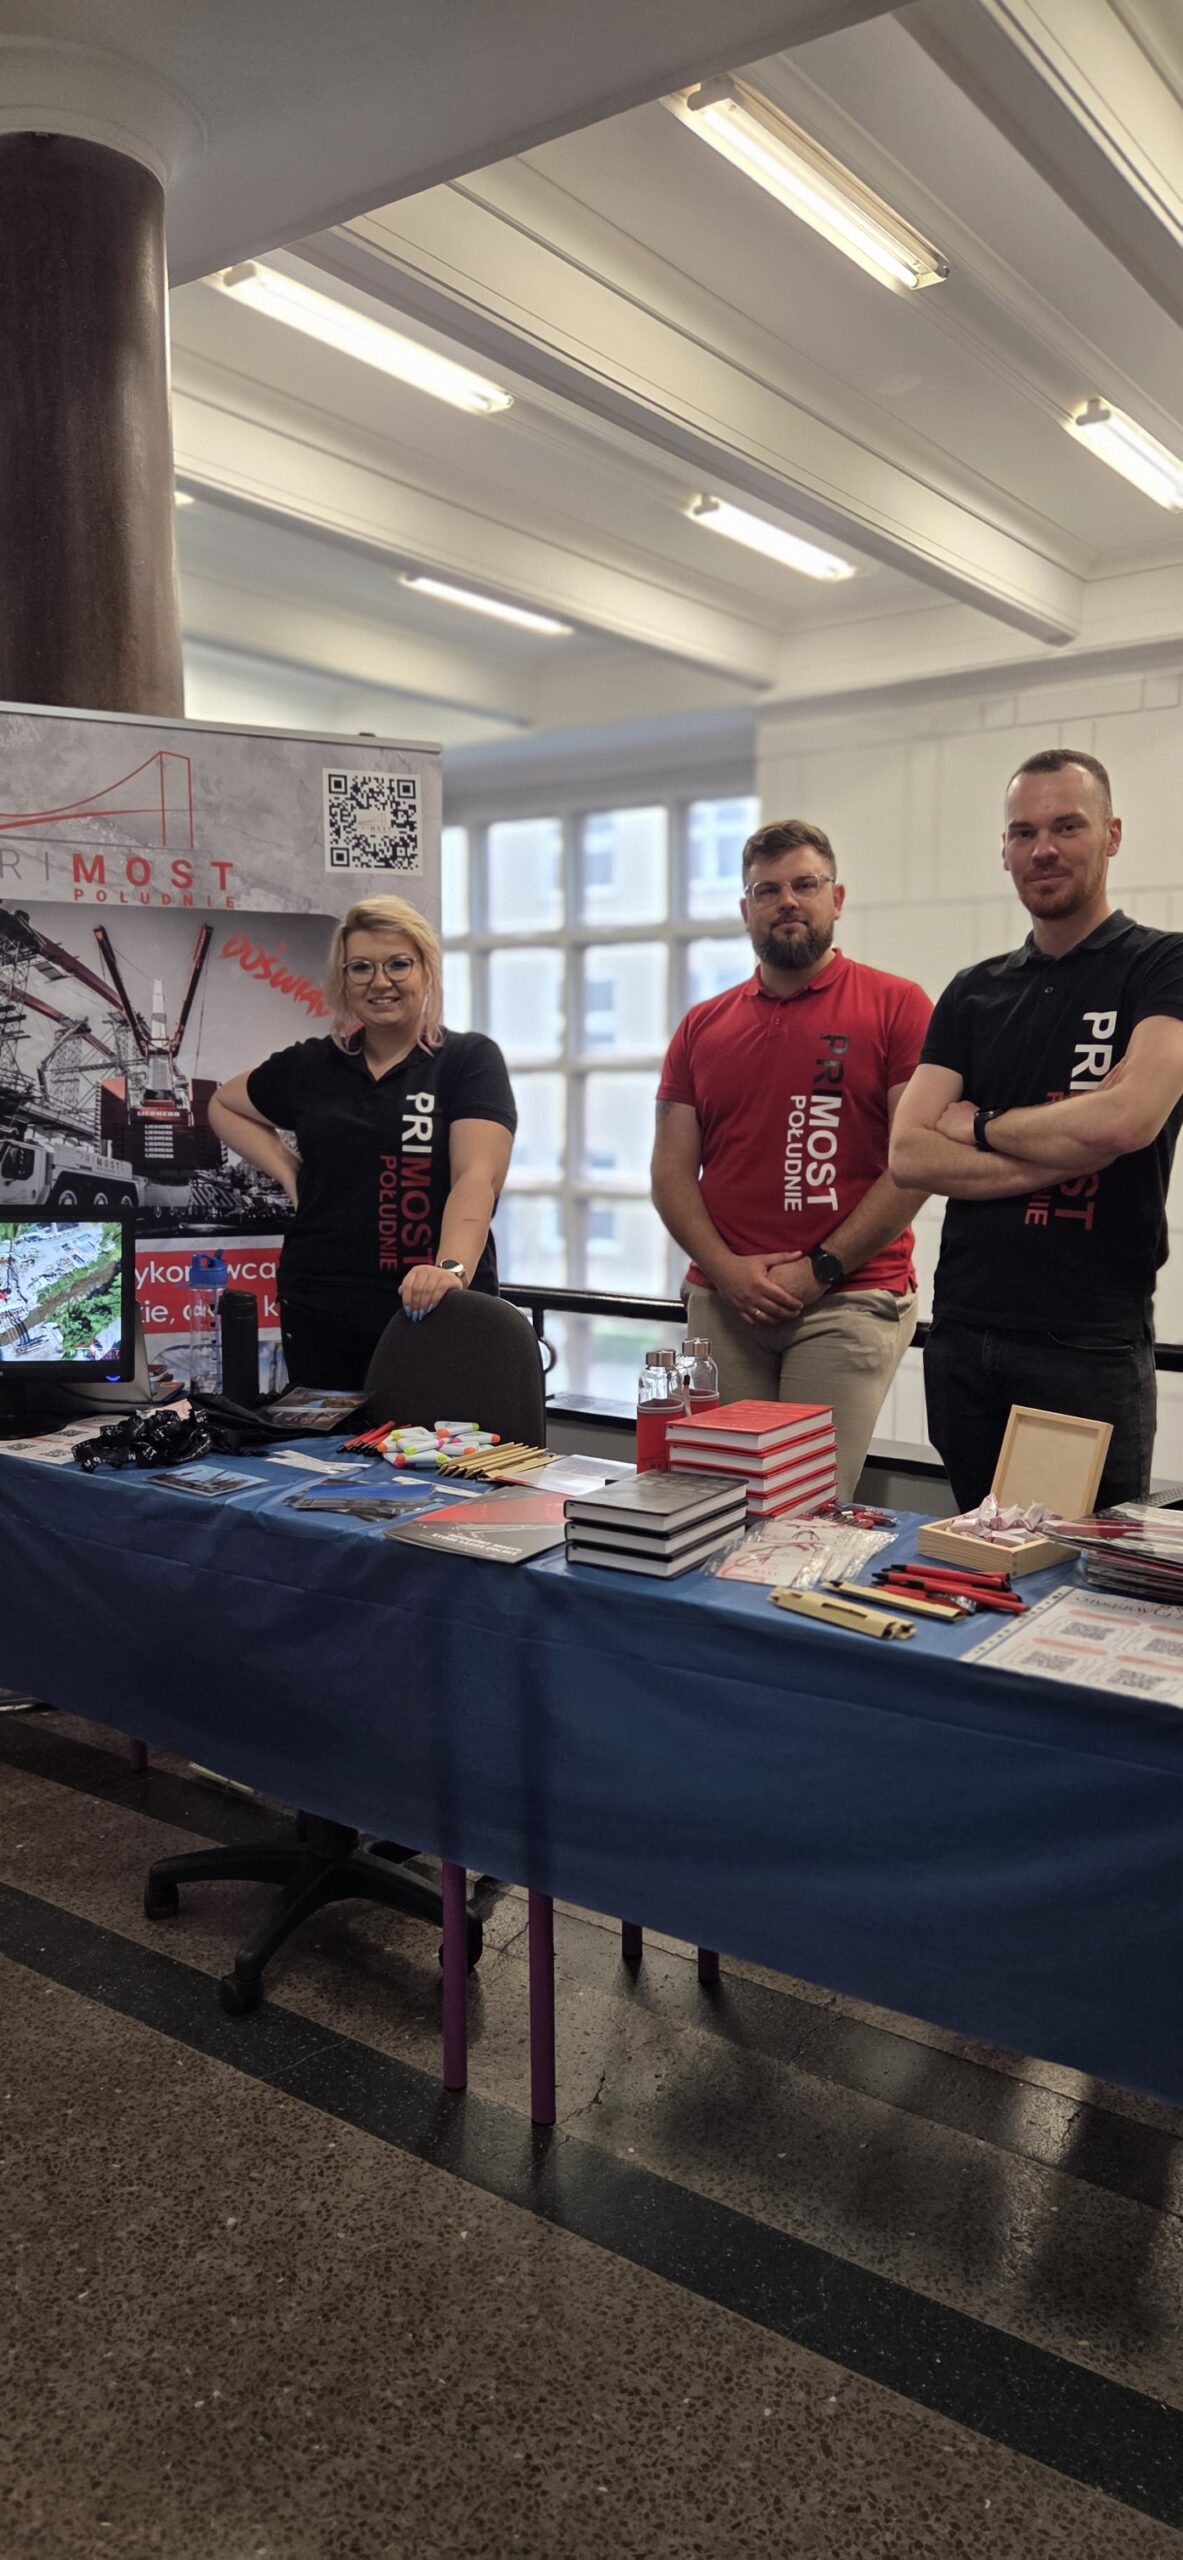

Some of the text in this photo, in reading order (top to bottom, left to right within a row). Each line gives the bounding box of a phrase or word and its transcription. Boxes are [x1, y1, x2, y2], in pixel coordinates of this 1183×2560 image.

[0, 848, 233, 891] RIMOST
[73, 888, 236, 909] POŁUDNIE
[401, 1091, 435, 1267] PRIMOST
[784, 1095, 806, 1212] POŁUDNIE
[805, 1033, 849, 1212] PRIMOST
[378, 1154, 398, 1272] POŁUDNIE
